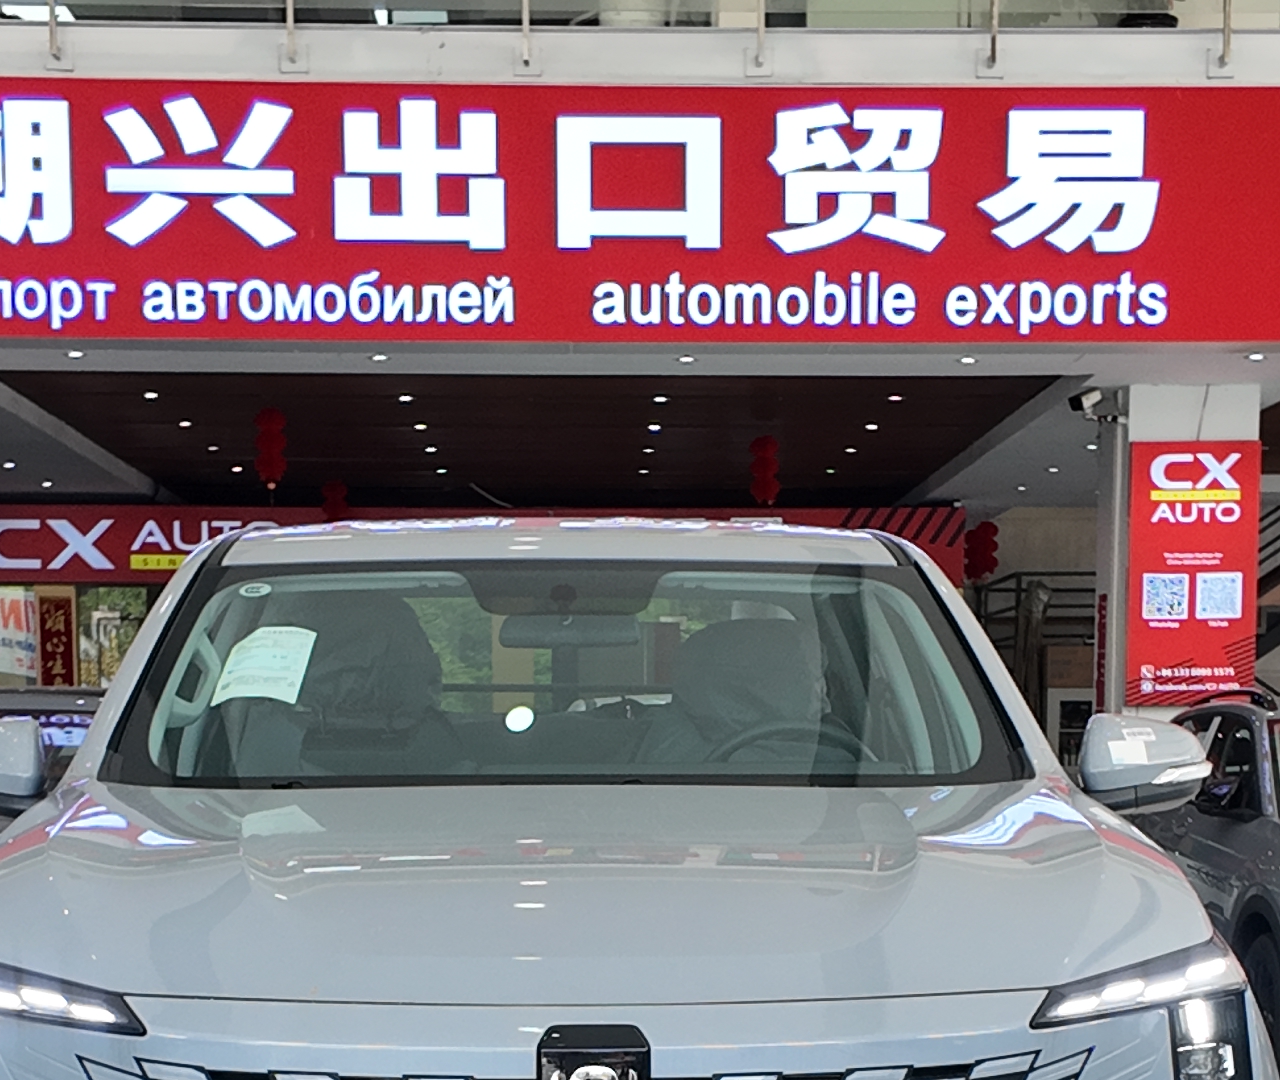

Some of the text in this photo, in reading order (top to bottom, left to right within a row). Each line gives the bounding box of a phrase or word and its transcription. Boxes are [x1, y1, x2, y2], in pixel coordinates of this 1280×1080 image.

[142, 270, 515, 325] автомобилей
[592, 271, 1168, 334] automobile exports
[1150, 453, 1241, 489] CX
[1150, 502, 1240, 523] AUTO
